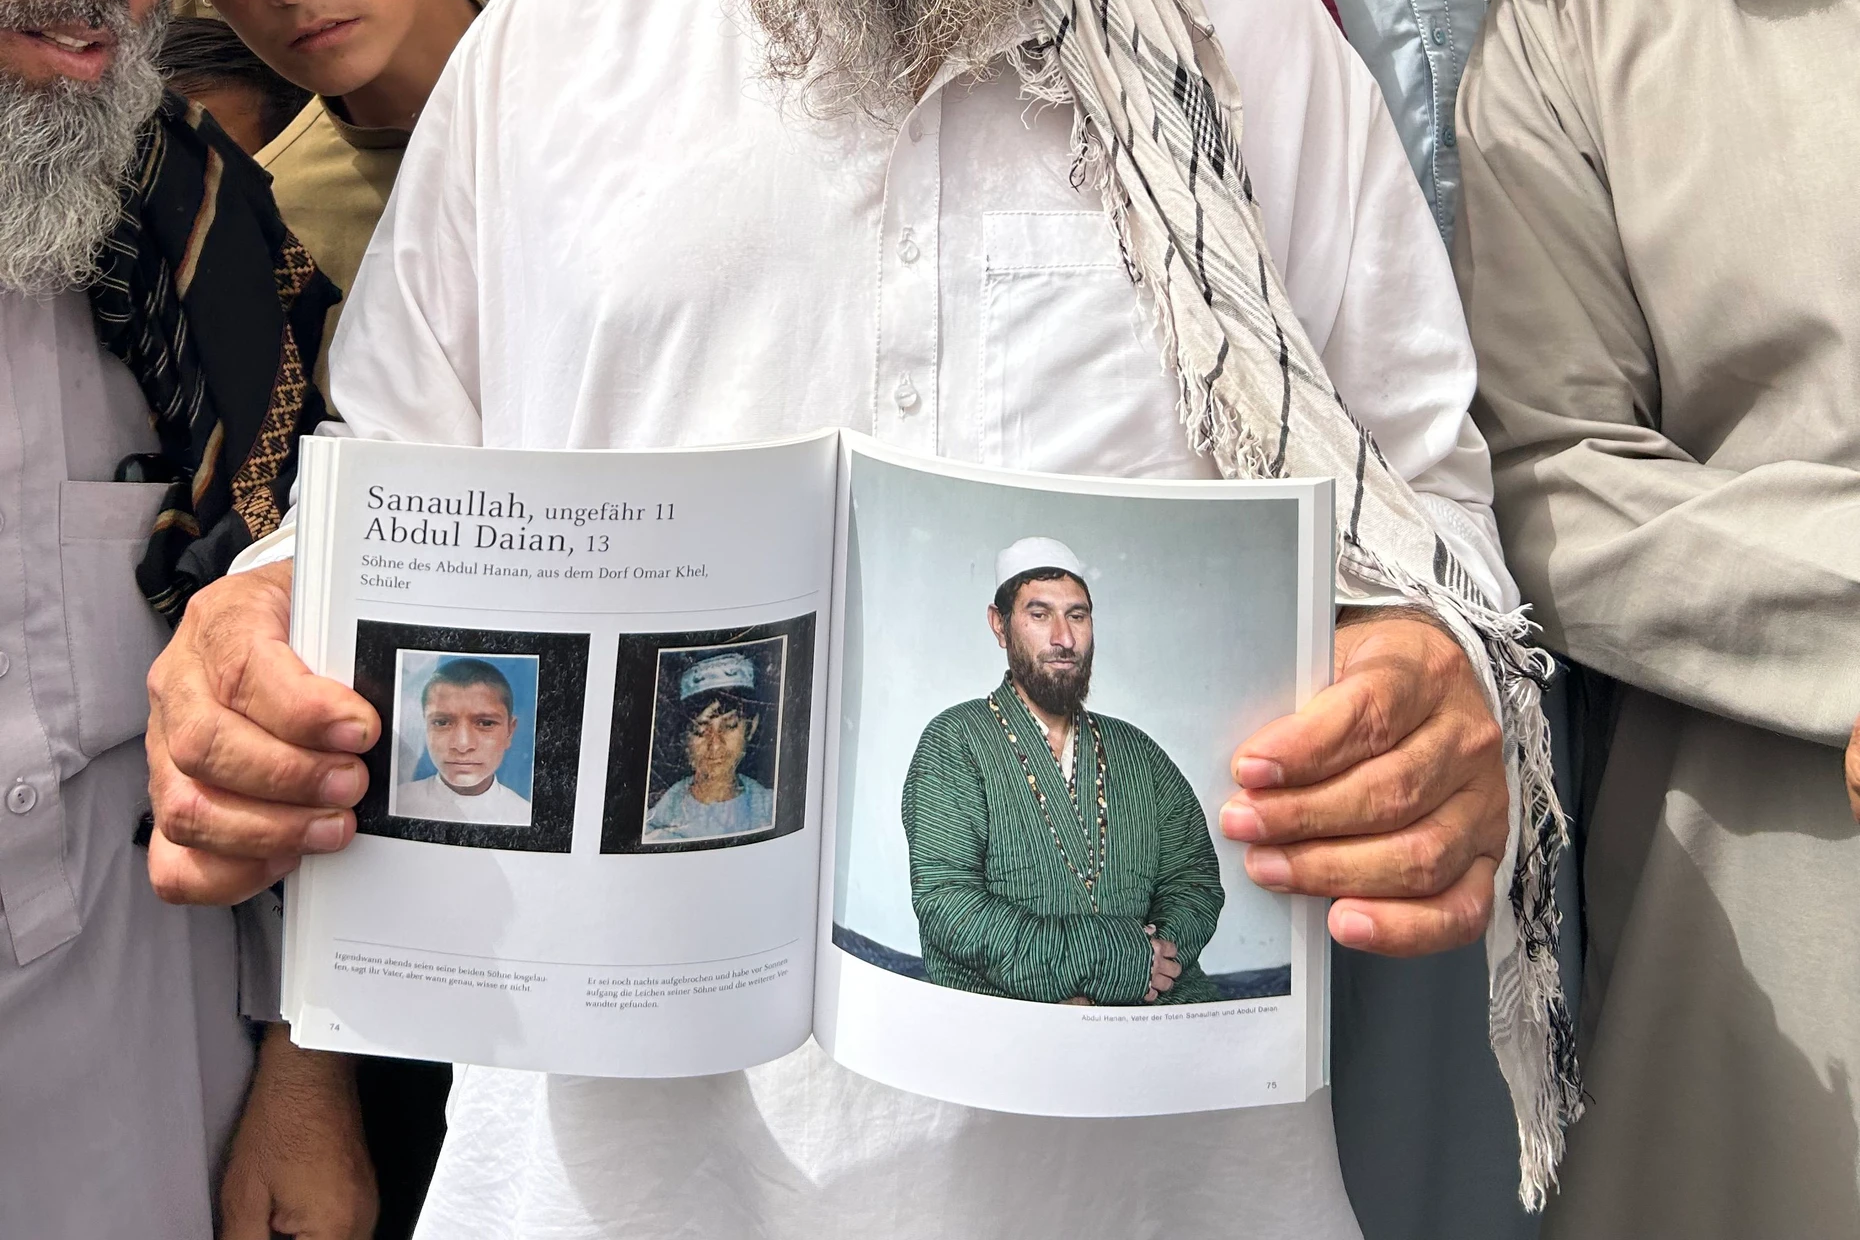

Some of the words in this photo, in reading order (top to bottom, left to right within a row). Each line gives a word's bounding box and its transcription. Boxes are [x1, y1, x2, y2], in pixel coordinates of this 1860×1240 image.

[367, 485, 534, 523] Sanaullah,
[545, 502, 645, 526] ungefähr
[655, 502, 675, 521] 11
[364, 516, 462, 547] Abdul
[474, 524, 575, 557] Daian,
[586, 535, 610, 552] 13
[361, 554, 405, 570] Söhne
[408, 558, 432, 572] des
[436, 560, 478, 575] Abdul
[482, 563, 533, 579] Hanan,
[536, 567, 560, 579] aus
[564, 566, 594, 579] dem
[599, 566, 629, 579] Dorf
[632, 566, 671, 579] Omar
[675, 565, 709, 579] Khel,
[360, 573, 411, 590] Schüler
[335, 951, 382, 965] Irgendwann
[384, 957, 412, 968] abends
[414, 961, 434, 970] seien
[436, 963, 456, 974] seine
[458, 966, 485, 977] beiden
[487, 969, 512, 980] Söhne
[588, 977, 597, 985] Er
[599, 978, 610, 986] sei
[612, 977, 631, 986] noch
[633, 976, 659, 986] nachts
[661, 974, 714, 986] aufgebrochen
[715, 971, 731, 980] und
[732, 968, 750, 978] habe
[751, 965, 763, 974] vor
[350, 964, 367, 975] sagt
[368, 966, 381, 975] ihr
[382, 967, 405, 979] Vater,
[406, 970, 423, 981] aber
[425, 974, 447, 983] wann
[449, 977, 475, 988] genau,
[476, 979, 498, 989] wisse
[499, 982, 508, 990] er
[586, 988, 618, 998] aufgang
[620, 988, 633, 997] die
[634, 988, 666, 997] Leichen
[667, 987, 691, 996] seiner
[693, 985, 717, 994] Söhne
[719, 982, 734, 991] und
[735, 979, 747, 990] die
[748, 974, 776, 987] weiterer
[585, 1000, 618, 1008] wandter
[619, 1000, 659, 1010] gefunden.
[1082, 1014, 1102, 1022] Abdul
[1103, 1014, 1129, 1022] Hanan,
[1131, 1014, 1149, 1022] Vater
[1186, 1010, 1220, 1019] Sanaullah
[1236, 1007, 1257, 1015] Abdul
[1258, 1005, 1278, 1013] Daian
[329, 1023, 340, 1032] 74
[1267, 1081, 1277, 1089] 75
